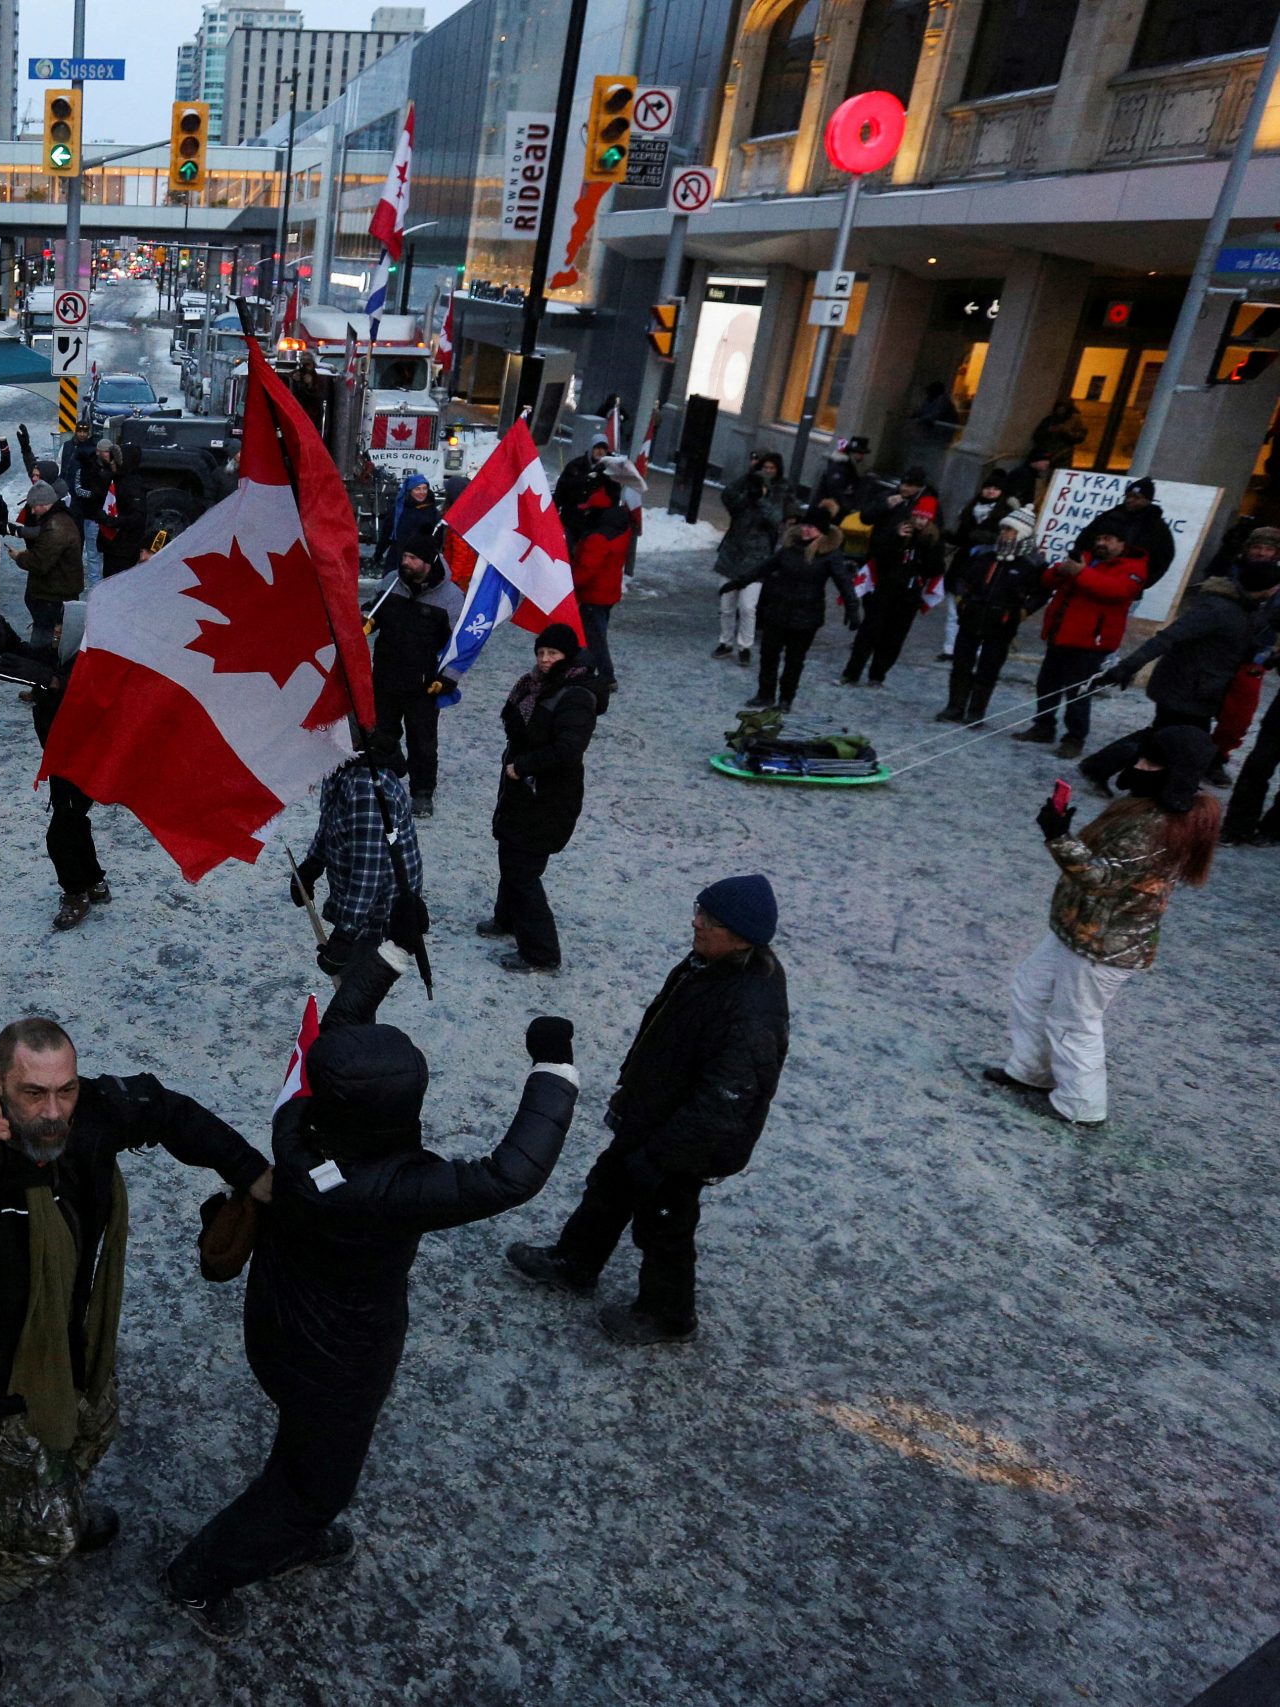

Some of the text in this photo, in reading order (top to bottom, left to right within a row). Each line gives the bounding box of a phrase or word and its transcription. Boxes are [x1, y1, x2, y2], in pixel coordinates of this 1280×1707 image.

[59, 58, 115, 79] Sussex
[504, 127, 526, 225] DOWNTOWN
[402, 452, 431, 462] GROW
